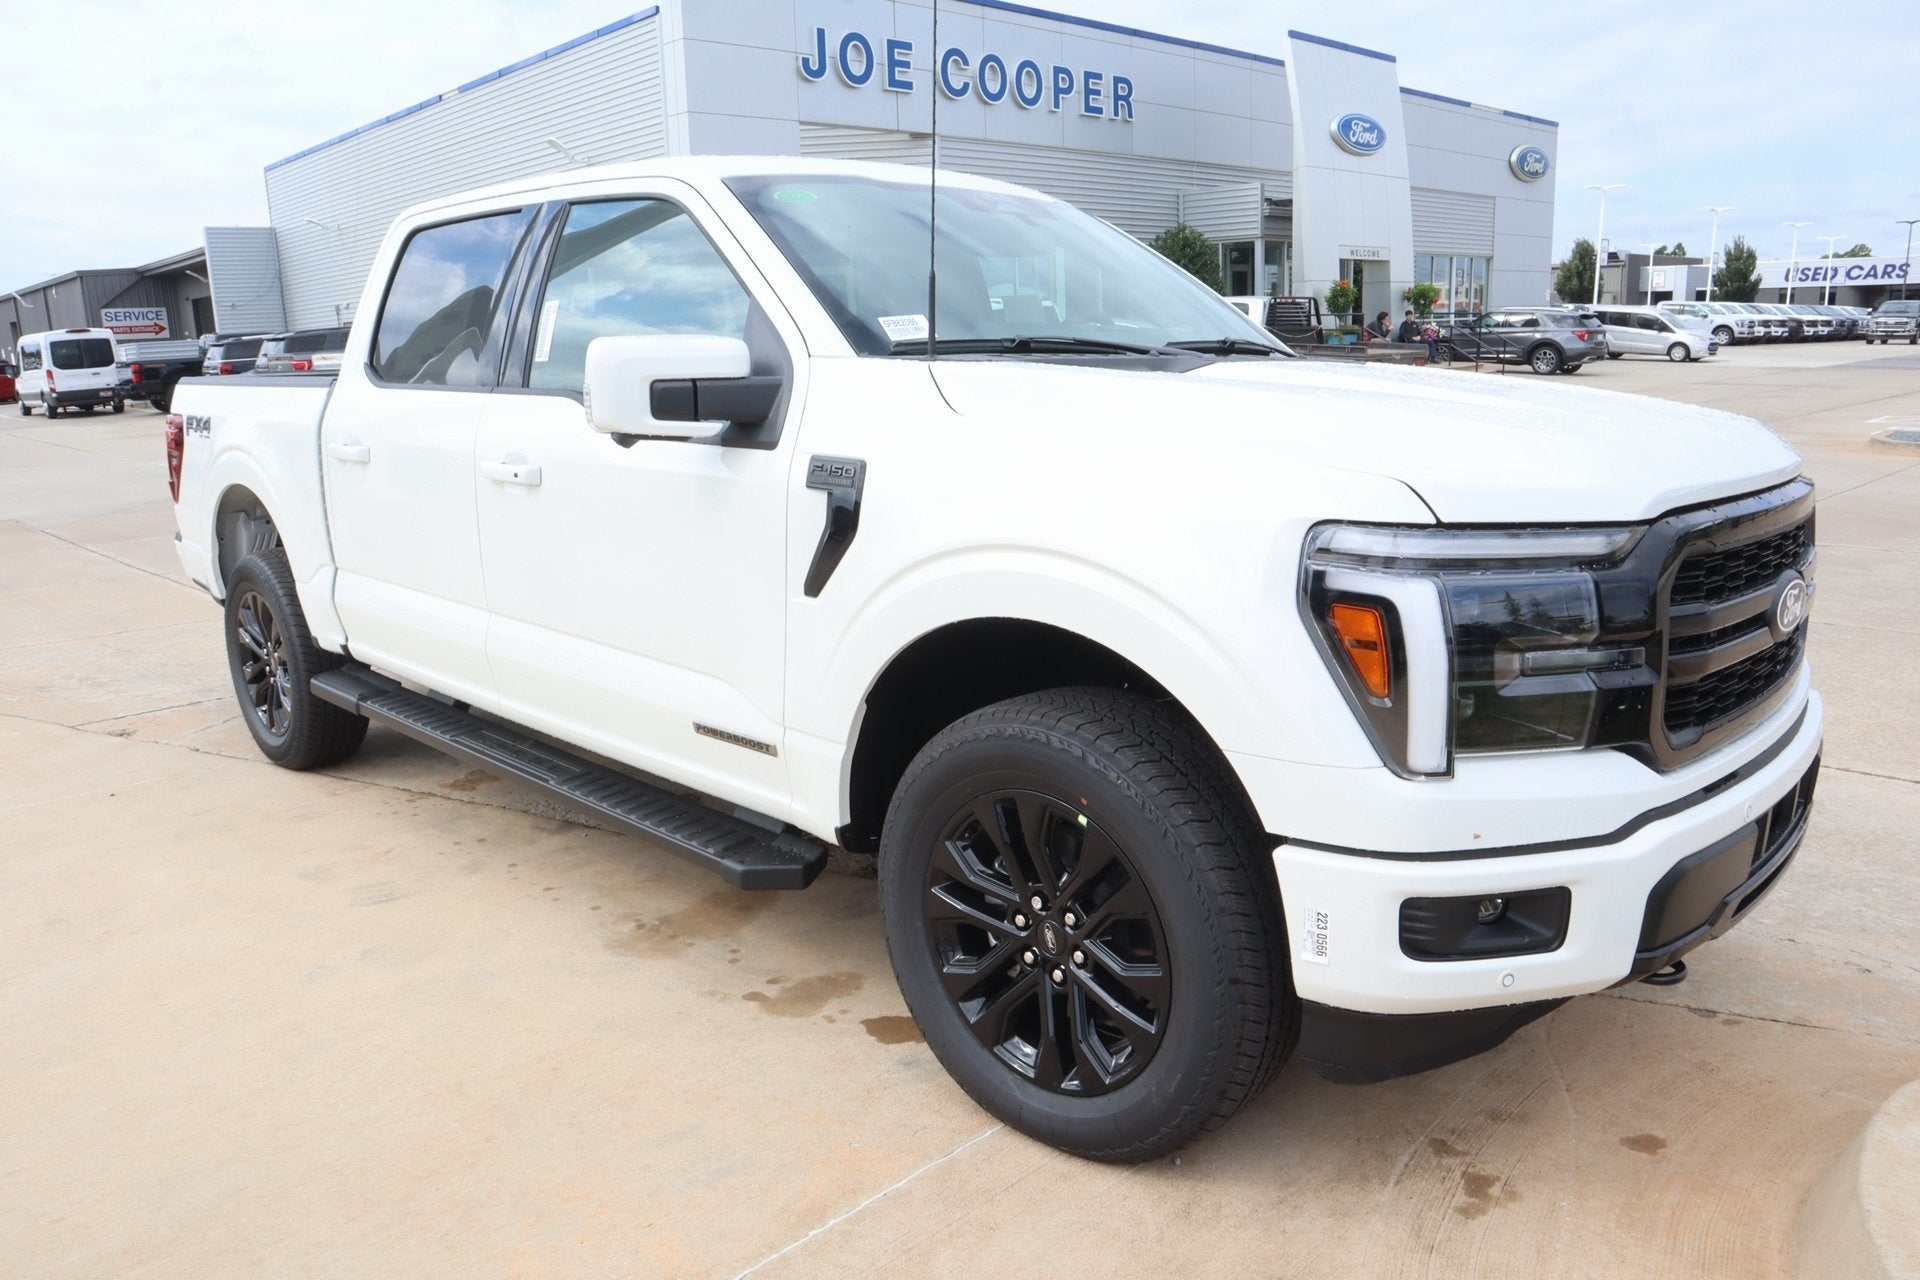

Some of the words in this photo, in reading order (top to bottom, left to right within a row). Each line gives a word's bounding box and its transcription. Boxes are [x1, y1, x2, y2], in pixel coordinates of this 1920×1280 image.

[801, 26, 915, 92] JOE
[939, 47, 1135, 121] COOPER
[1349, 119, 1379, 146] Ford
[1523, 152, 1546, 174] Ford
[1350, 249, 1381, 258] WELCOME
[1784, 266, 1839, 282] USED
[1845, 263, 1911, 280] CARS
[104, 310, 165, 322] SERVICE
[131, 325, 160, 333] ENTRANCE
[186, 415, 212, 436] FX4
[811, 463, 857, 478] F-150
[1783, 587, 1804, 625] Ford
[694, 722, 771, 752] POWERBOOST
[1316, 911, 1328, 931] 223
[1316, 933, 1328, 957] 0566
